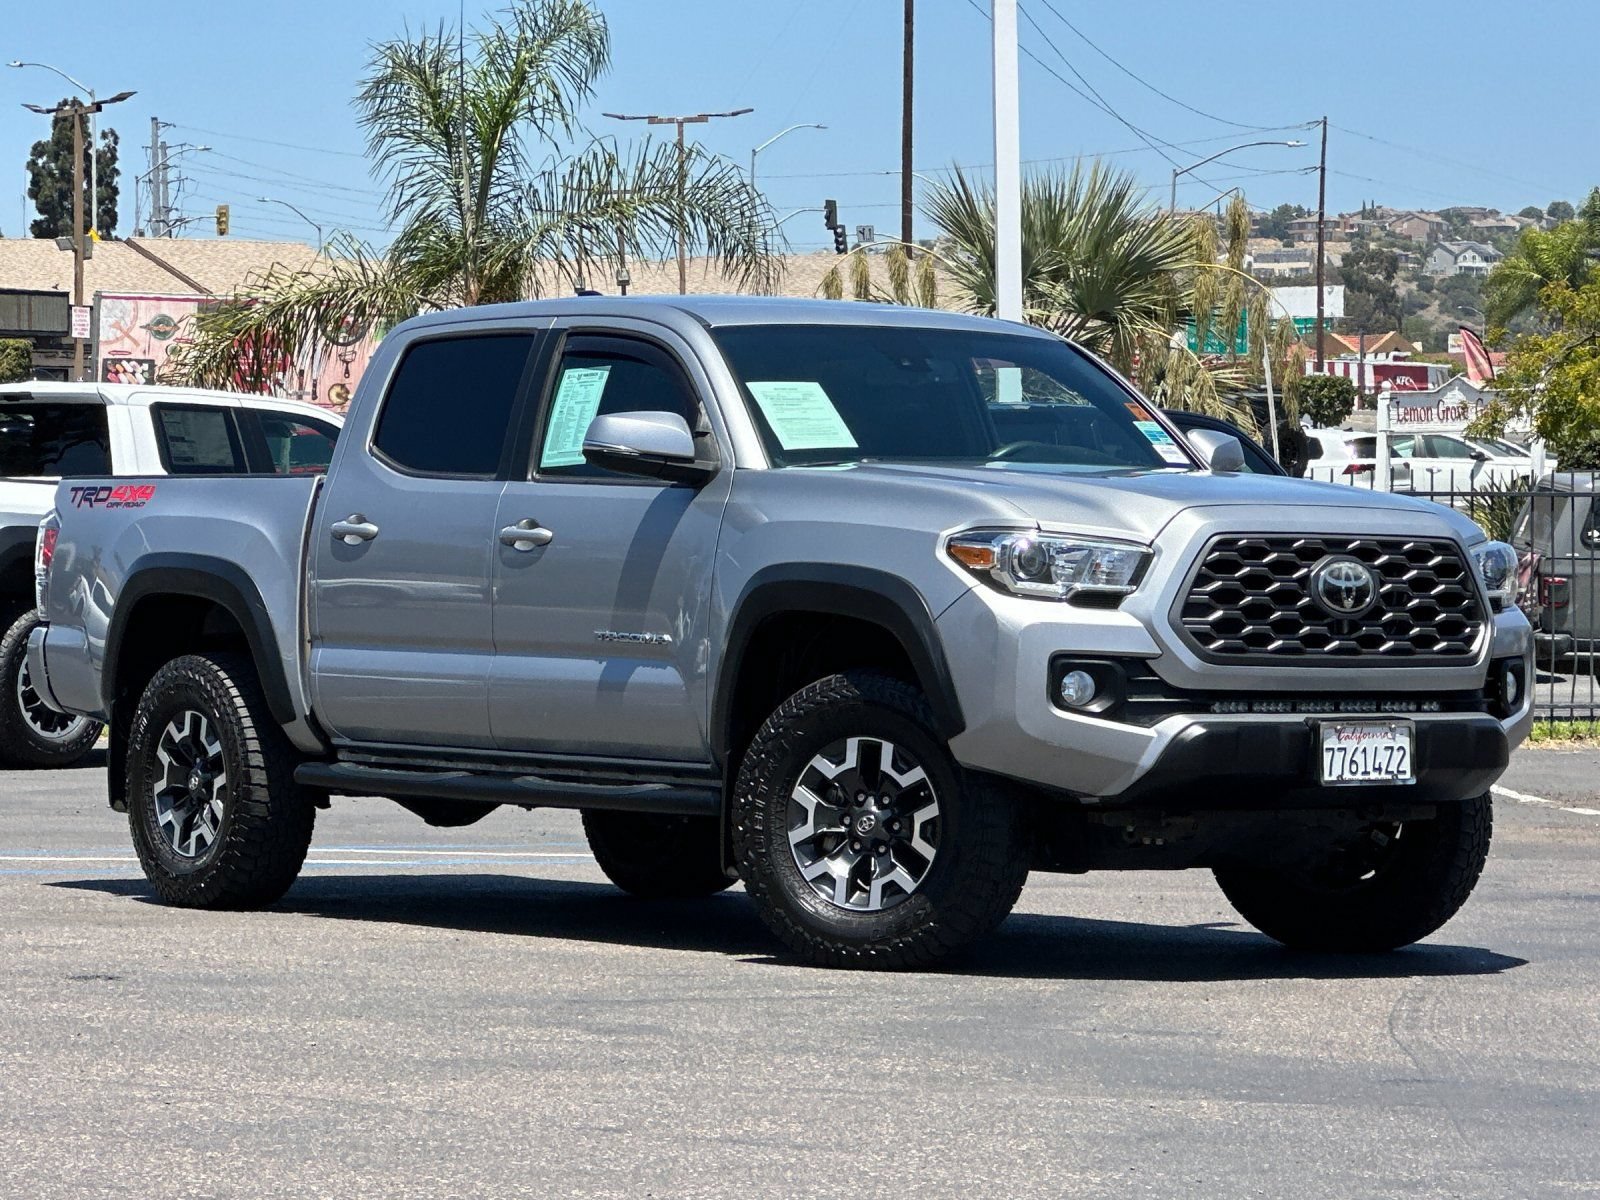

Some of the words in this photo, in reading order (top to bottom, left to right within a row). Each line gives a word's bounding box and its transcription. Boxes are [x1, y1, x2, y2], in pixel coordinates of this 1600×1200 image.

[1395, 376, 1411, 385] KFC
[1396, 400, 1433, 422] Lemon
[1436, 399, 1468, 422] Grove
[69, 486, 112, 508] TRD
[593, 631, 673, 644] TACOMA
[1337, 727, 1392, 744] California
